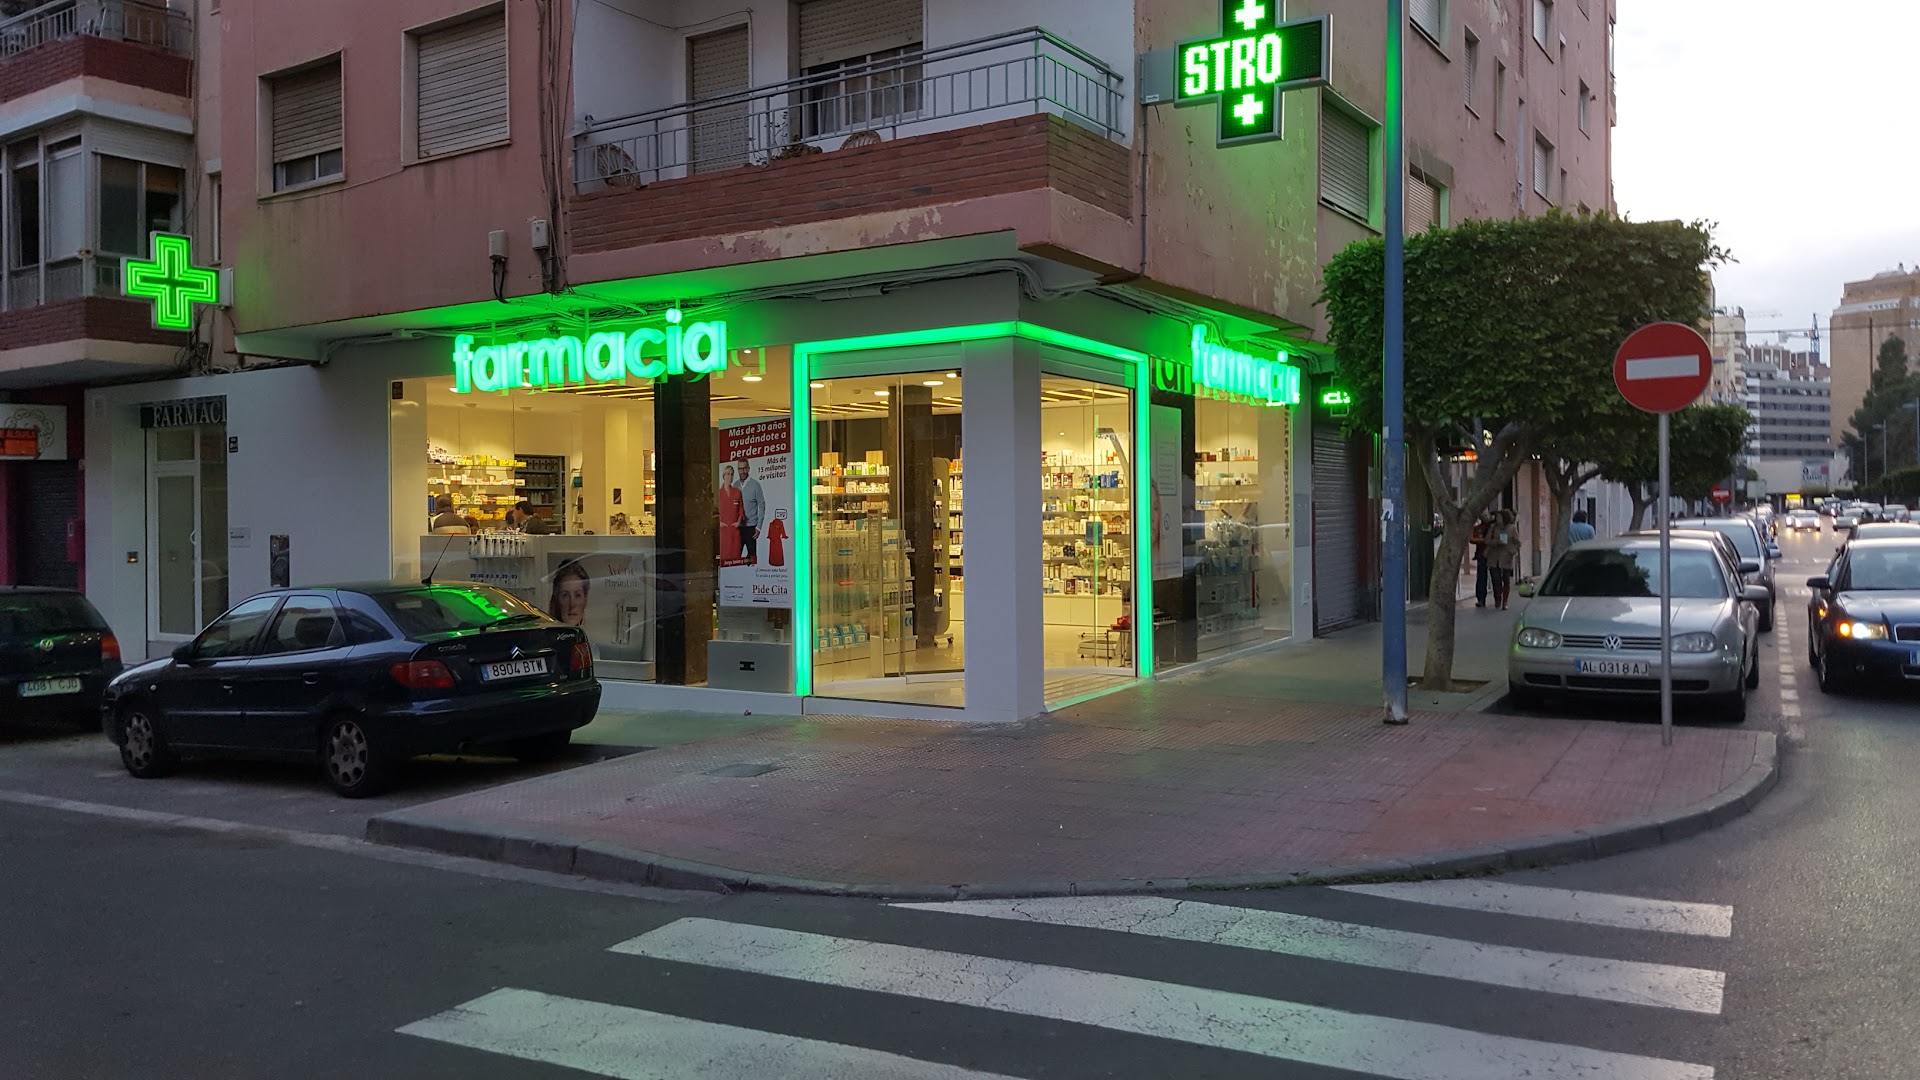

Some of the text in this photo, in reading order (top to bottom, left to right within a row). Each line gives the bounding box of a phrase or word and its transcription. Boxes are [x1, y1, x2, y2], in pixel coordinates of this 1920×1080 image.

[1184, 32, 1283, 96] STRO
[453, 308, 727, 393] farmacia
[1192, 324, 1300, 405] farmacia
[728, 421, 786, 437] Más de 30 años
[730, 433, 779, 448] ayudándote
[730, 443, 786, 461] perder peso
[767, 455, 787, 465] Más de
[759, 471, 786, 481] de visitas
[752, 584, 770, 594] Pide
[771, 585, 788, 594] Cita
[492, 659, 544, 677] 8904 BTW
[1582, 661, 1648, 674] AL 0318 AJ
